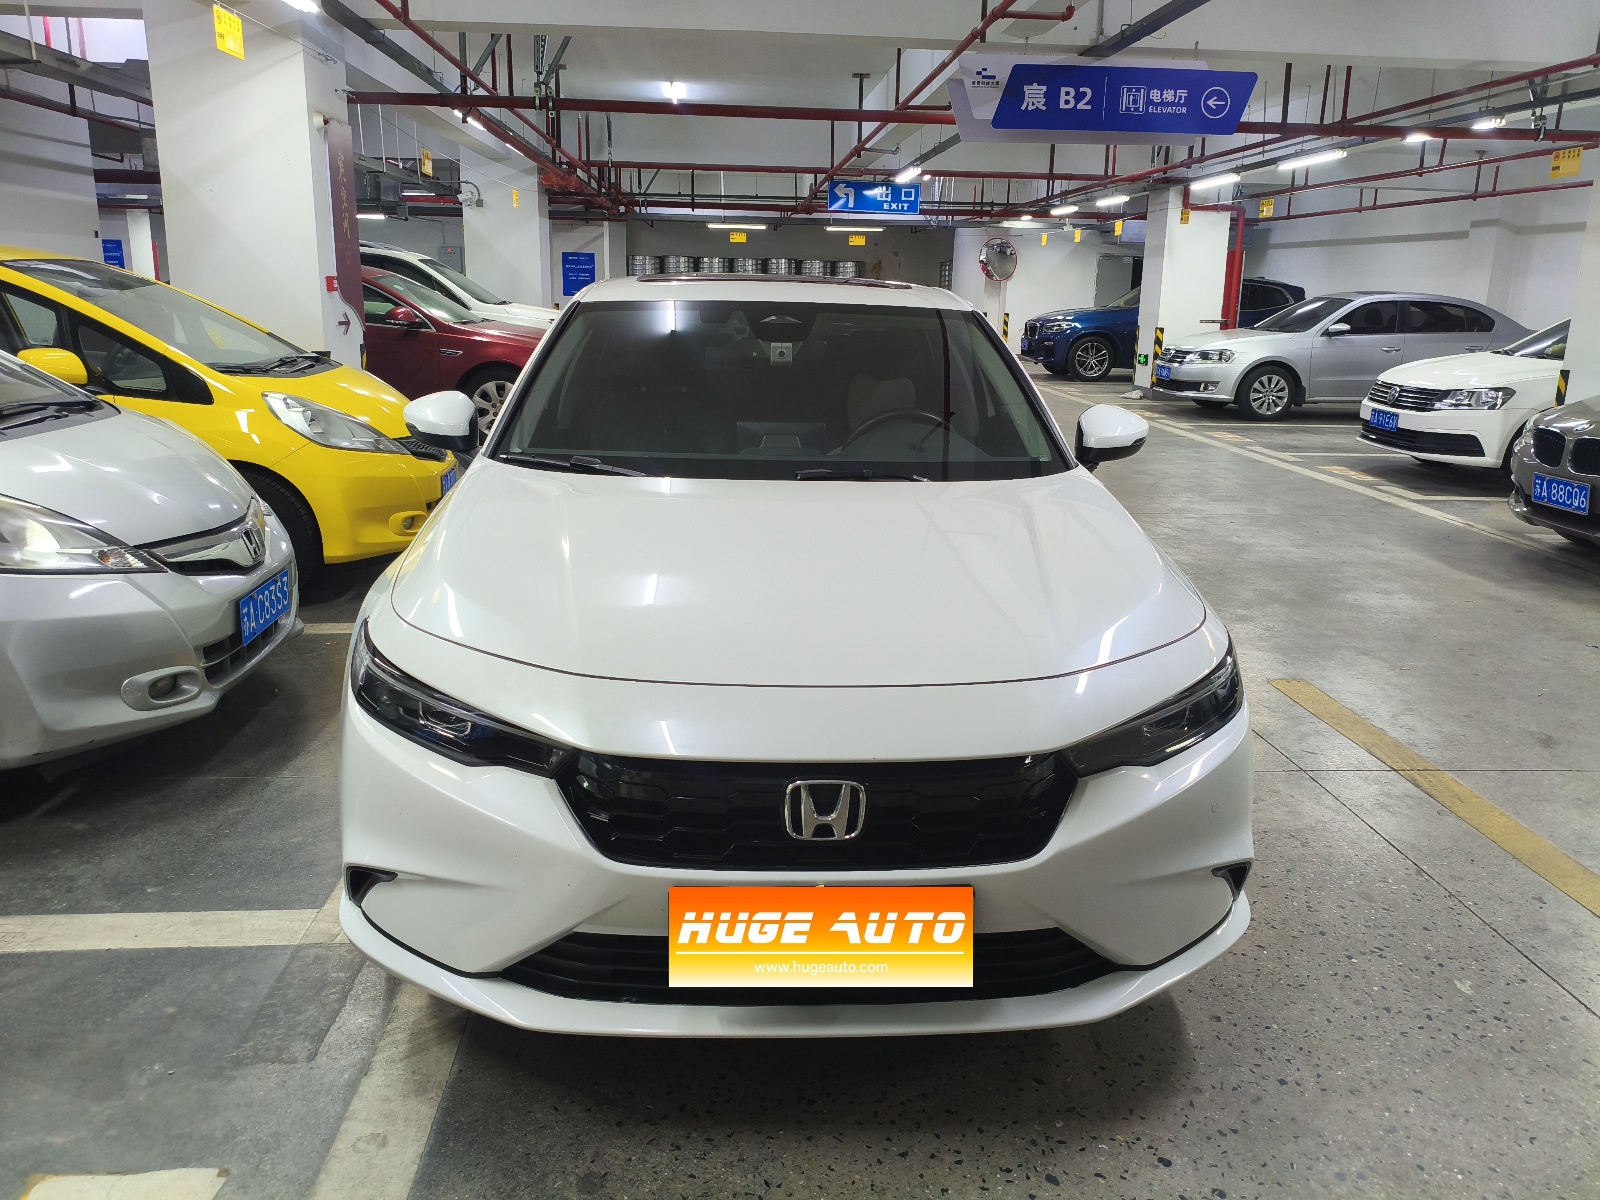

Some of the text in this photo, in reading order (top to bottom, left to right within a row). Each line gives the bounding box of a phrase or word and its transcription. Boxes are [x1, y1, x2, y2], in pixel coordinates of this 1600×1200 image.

[1020, 82, 1092, 111] 宸 B2
[1149, 88, 1188, 104] 电梯厅
[1148, 105, 1187, 114] ELEVATOR
[876, 185, 915, 202] 出口
[883, 202, 909, 211] EXIT
